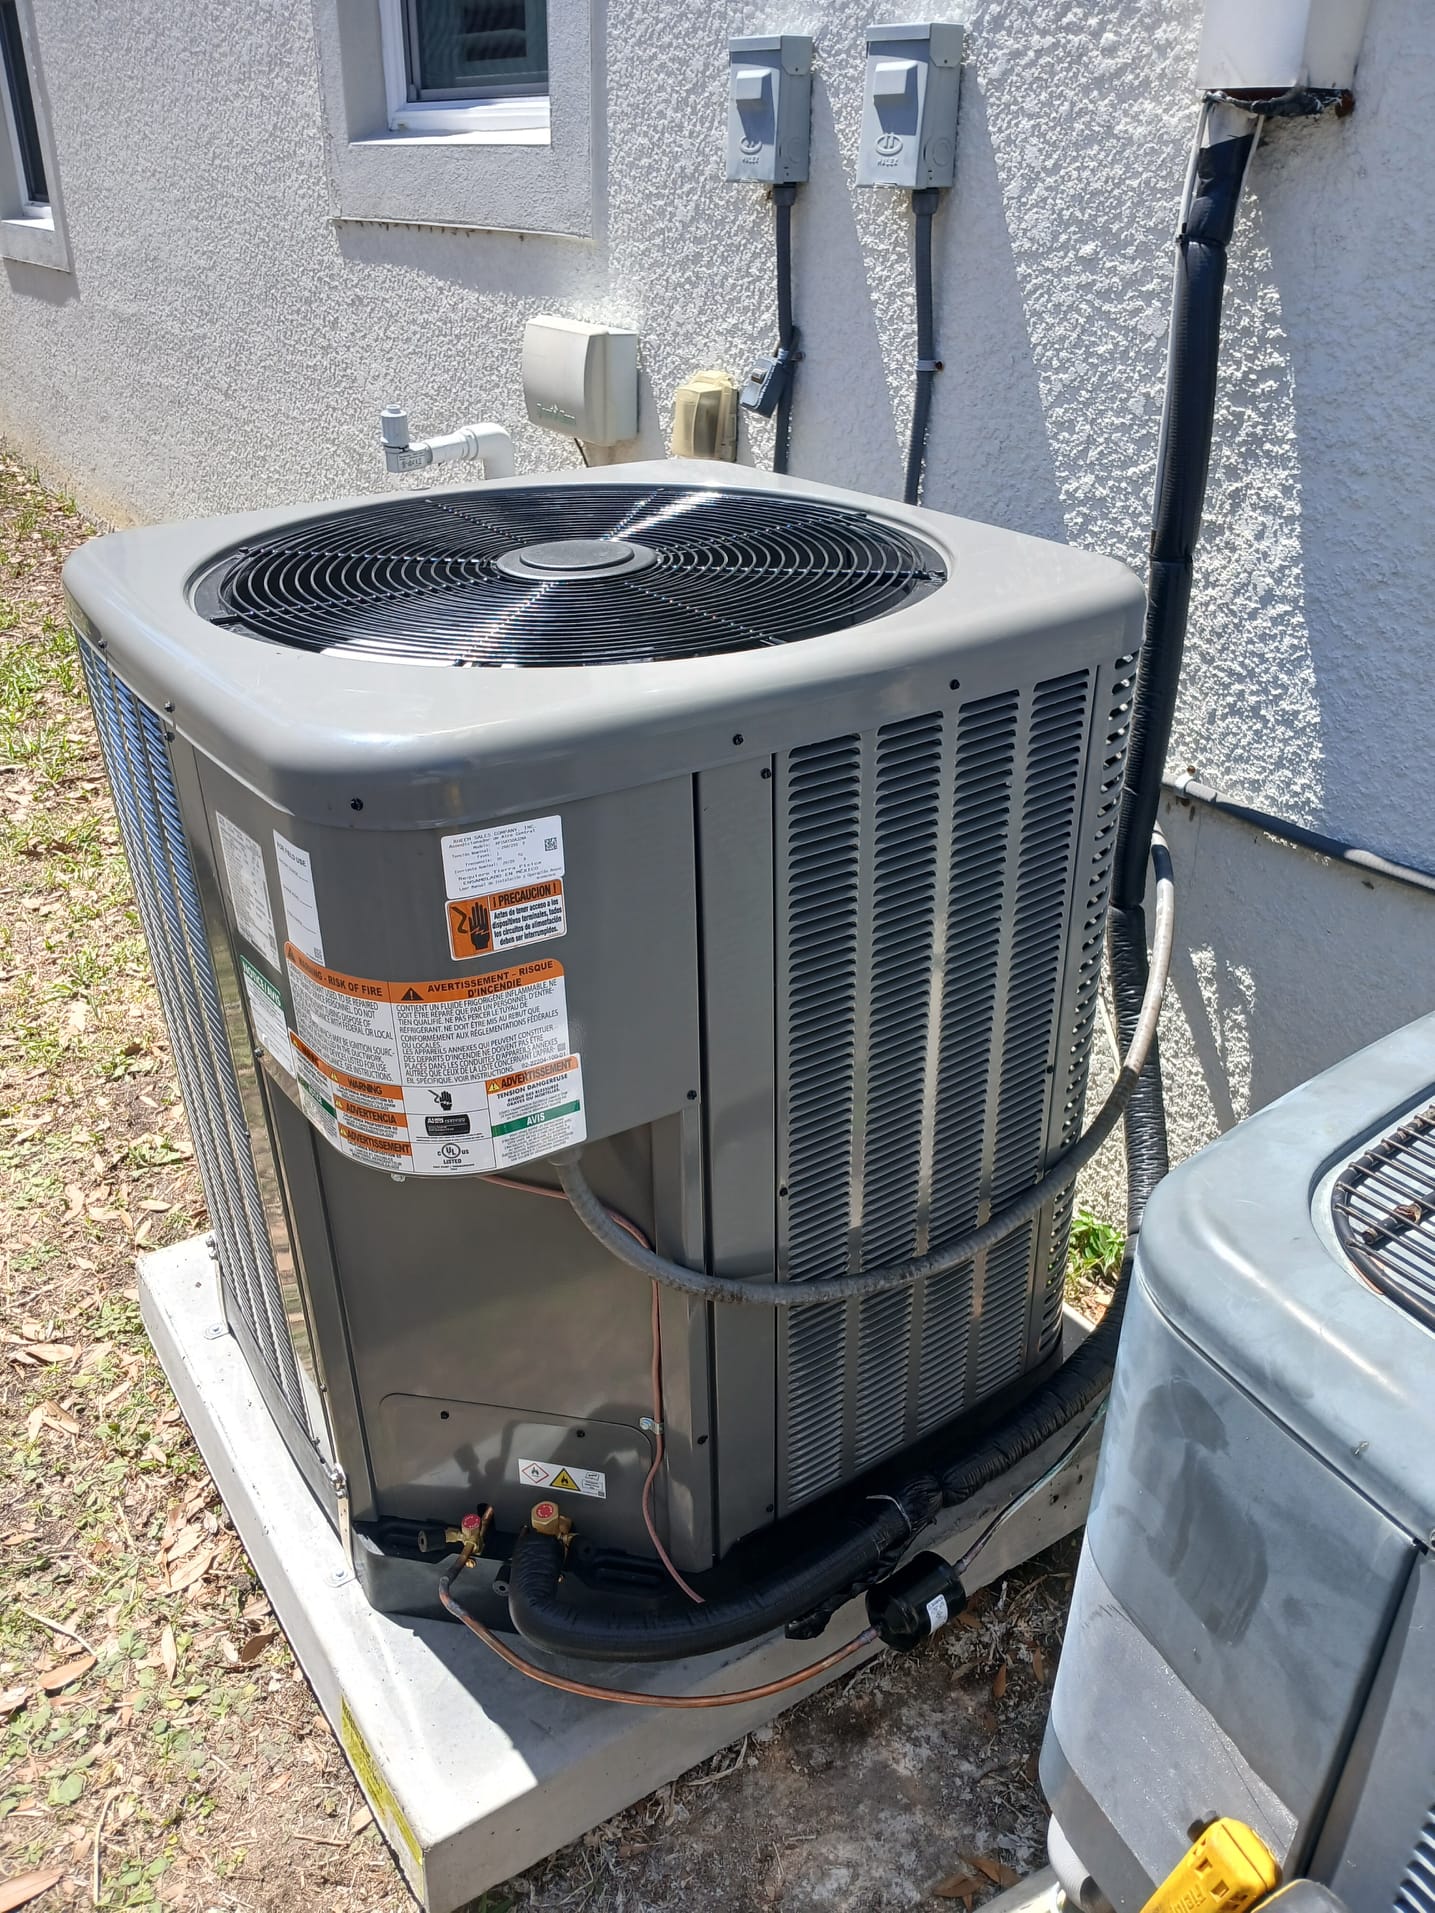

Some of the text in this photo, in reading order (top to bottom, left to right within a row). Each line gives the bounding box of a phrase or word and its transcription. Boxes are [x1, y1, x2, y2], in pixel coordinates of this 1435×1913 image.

[295, 856, 306, 867] USE
[498, 886, 551, 906] PRECAUCION
[492, 906, 562, 929] dispositivos terminales, todos
[494, 911, 508, 920] Antes
[516, 906, 528, 915] tener
[529, 902, 546, 911] acceso
[494, 916, 562, 938] los circuitos de alimentación
[499, 936, 515, 946] deben
[524, 926, 558, 940] interrumpidos.
[328, 975, 346, 989] RISK
[348, 982, 359, 992] OF
[361, 984, 383, 996] FIRE
[427, 960, 553, 993] AVERTISSEMENT RISQUE
[467, 977, 522, 998] D'INCENDIE
[354, 1008, 363, 1017] DO
[363, 1010, 375, 1019] NOT
[441, 1000, 463, 1010] FLUIDE
[455, 1007, 470, 1016] QUE
[470, 1004, 481, 1013] PAR
[483, 1002, 492, 1010] UN
[493, 993, 528, 1008] PERSONNEL
[455, 1014, 466, 1022] PAS
[467, 1009, 491, 1021] PERCER
[500, 1002, 519, 1013] TUYAU
[519, 1000, 528, 1008] DE
[400, 1030, 454, 1042] CONFORMÉMENT
[456, 1030, 469, 1039] AUX
[527, 1008, 559, 1023] FÉDÉRALES
[454, 1022, 469, 1031] DOIT
[470, 1018, 485, 1028] ÊTRE
[486, 1016, 497, 1024] MIS
[498, 1014, 507, 1022] AU
[508, 1009, 527, 1019] REBUT
[527, 1005, 540, 1014] QUE
[365, 1028, 374, 1037] OR
[374, 1029, 394, 1040] LOCAL
[414, 1047, 447, 1055] APPAREILS
[448, 1042, 477, 1054] ANNEXES
[478, 1040, 489, 1049] QUI
[490, 1034, 516, 1046] PEUVENT
[517, 1024, 554, 1039] CONSTITUER
[428, 1061, 446, 1069] DANS
[459, 1054, 495, 1067] CONDUITES
[495, 1045, 531, 1060] D'APPAREILS
[532, 1037, 558, 1050] ANNEXES
[445, 1049, 481, 1061] D'INCENDIE
[482, 1048, 491, 1056] NE
[491, 1041, 517, 1053] DOIVENT
[518, 1038, 529, 1046] PAS
[364, 1060, 375, 1070] FOR
[405, 1068, 428, 1077] AUTRES
[429, 1069, 442, 1077] QUE
[443, 1068, 459, 1076] CEUX
[470, 1065, 478, 1073] LA
[479, 1062, 493, 1071] LISTE
[494, 1052, 532, 1068] CONCERNANT
[501, 1059, 571, 1088] ADVERTISSEMENT
[348, 1077, 383, 1095] WARNING
[454, 1074, 469, 1082] VOIR
[497, 1073, 568, 1100] TENSION DANGEREUSE
[346, 1102, 397, 1124] ADVERTENCIA
[507, 1099, 525, 1107] GRAVES
[526, 1112, 545, 1126] AVIS
[347, 1129, 410, 1154] ADVERTISSEMENT
[446, 1146, 457, 1155] UL
